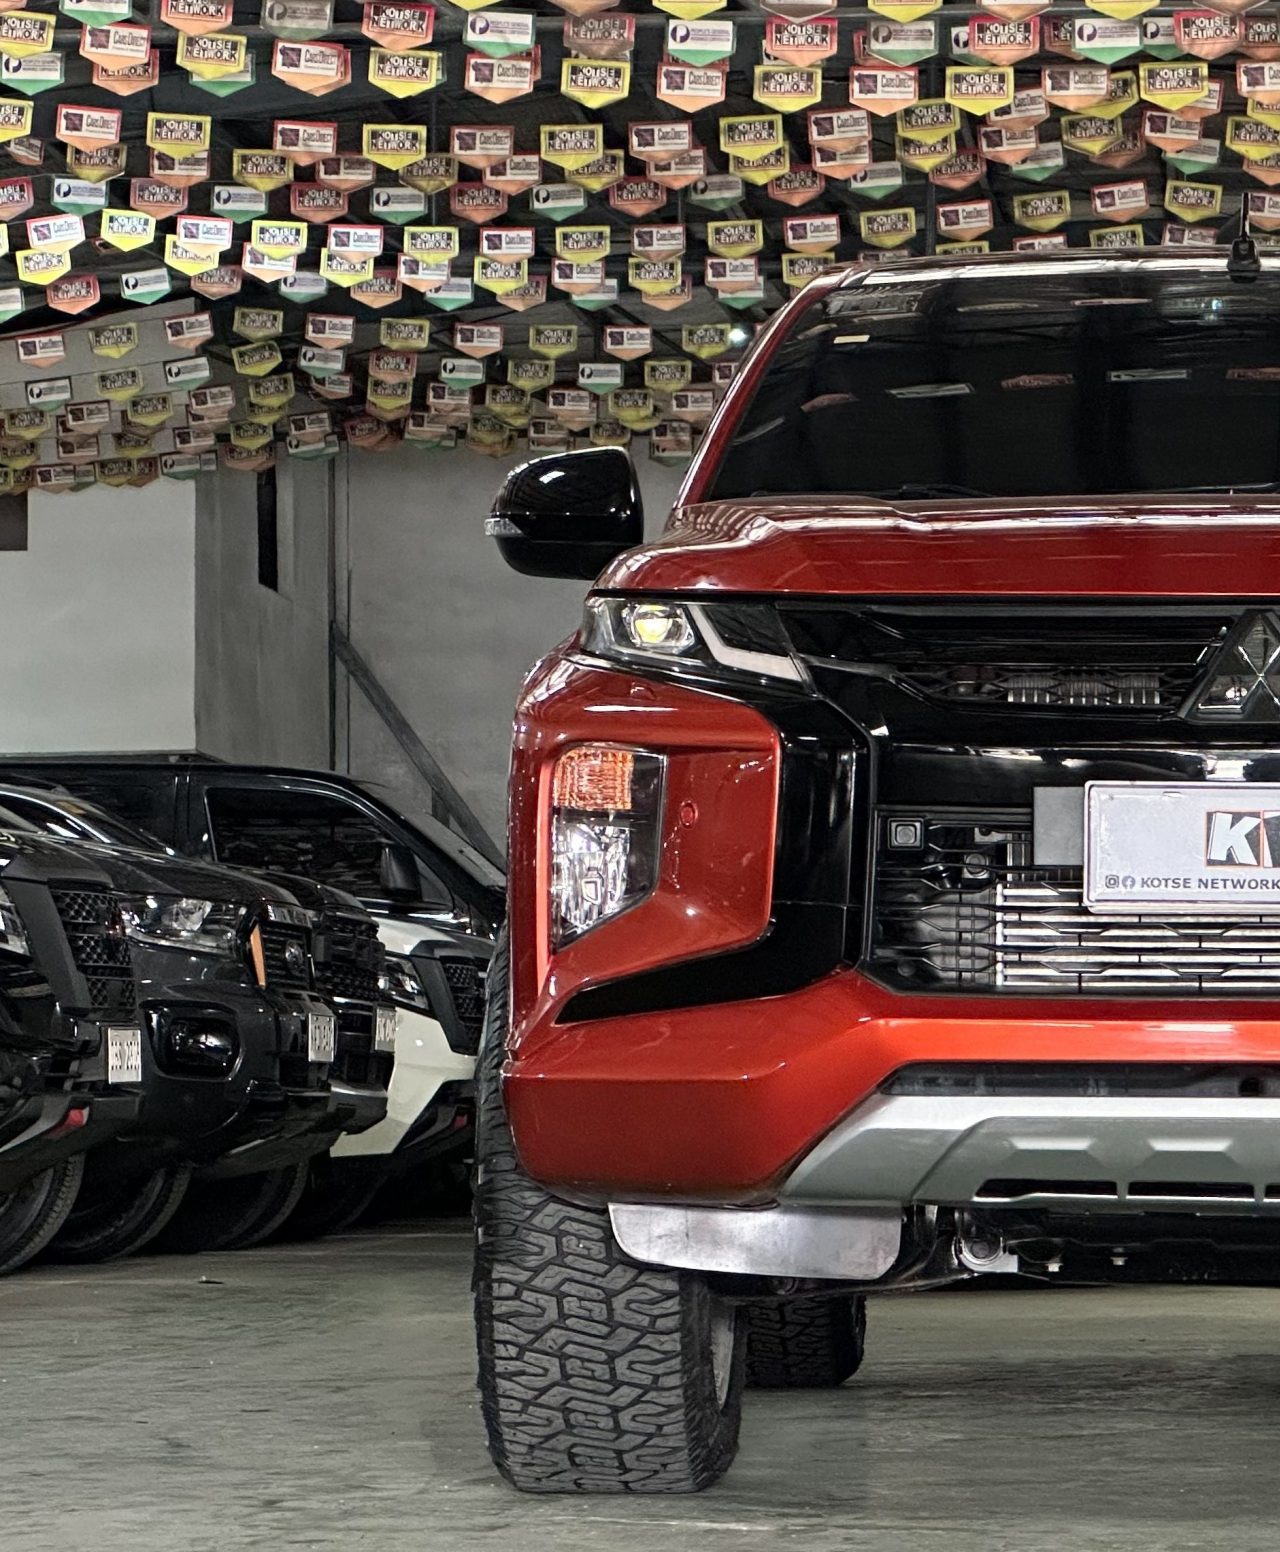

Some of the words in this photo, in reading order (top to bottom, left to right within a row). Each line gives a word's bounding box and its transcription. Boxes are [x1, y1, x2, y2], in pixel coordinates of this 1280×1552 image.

[170, 2, 223, 16] NETWORK
[381, 7, 419, 21] KOTSE
[373, 15, 425, 31] NETWORK
[581, 17, 619, 30] KOTSE
[986, 22, 1024, 33] KOTSE
[1190, 15, 1230, 28] KOTSE
[0, 25, 45, 41] ETWORK
[573, 27, 625, 40] NETWORK
[783, 23, 821, 34] KOTSE
[1183, 25, 1237, 38] NETWORK
[192, 37, 230, 50] KOTSE
[775, 33, 827, 44] NETWORK
[978, 32, 1030, 43] NETWORK
[185, 45, 237, 60] NETWORK
[384, 55, 422, 67] KOTSE
[377, 64, 429, 77] NETWORK
[577, 66, 613, 77] KOTSE
[1154, 68, 1192, 79] KOTSE
[570, 75, 620, 87] NETWORK
[769, 72, 807, 82] KOTSE
[960, 73, 998, 83] KOTSE
[1148, 76, 1200, 89] NETWORK
[762, 82, 814, 92] NETWORK
[954, 83, 1006, 93] NETWORK
[1140, 877, 1192, 889] KOTSE
